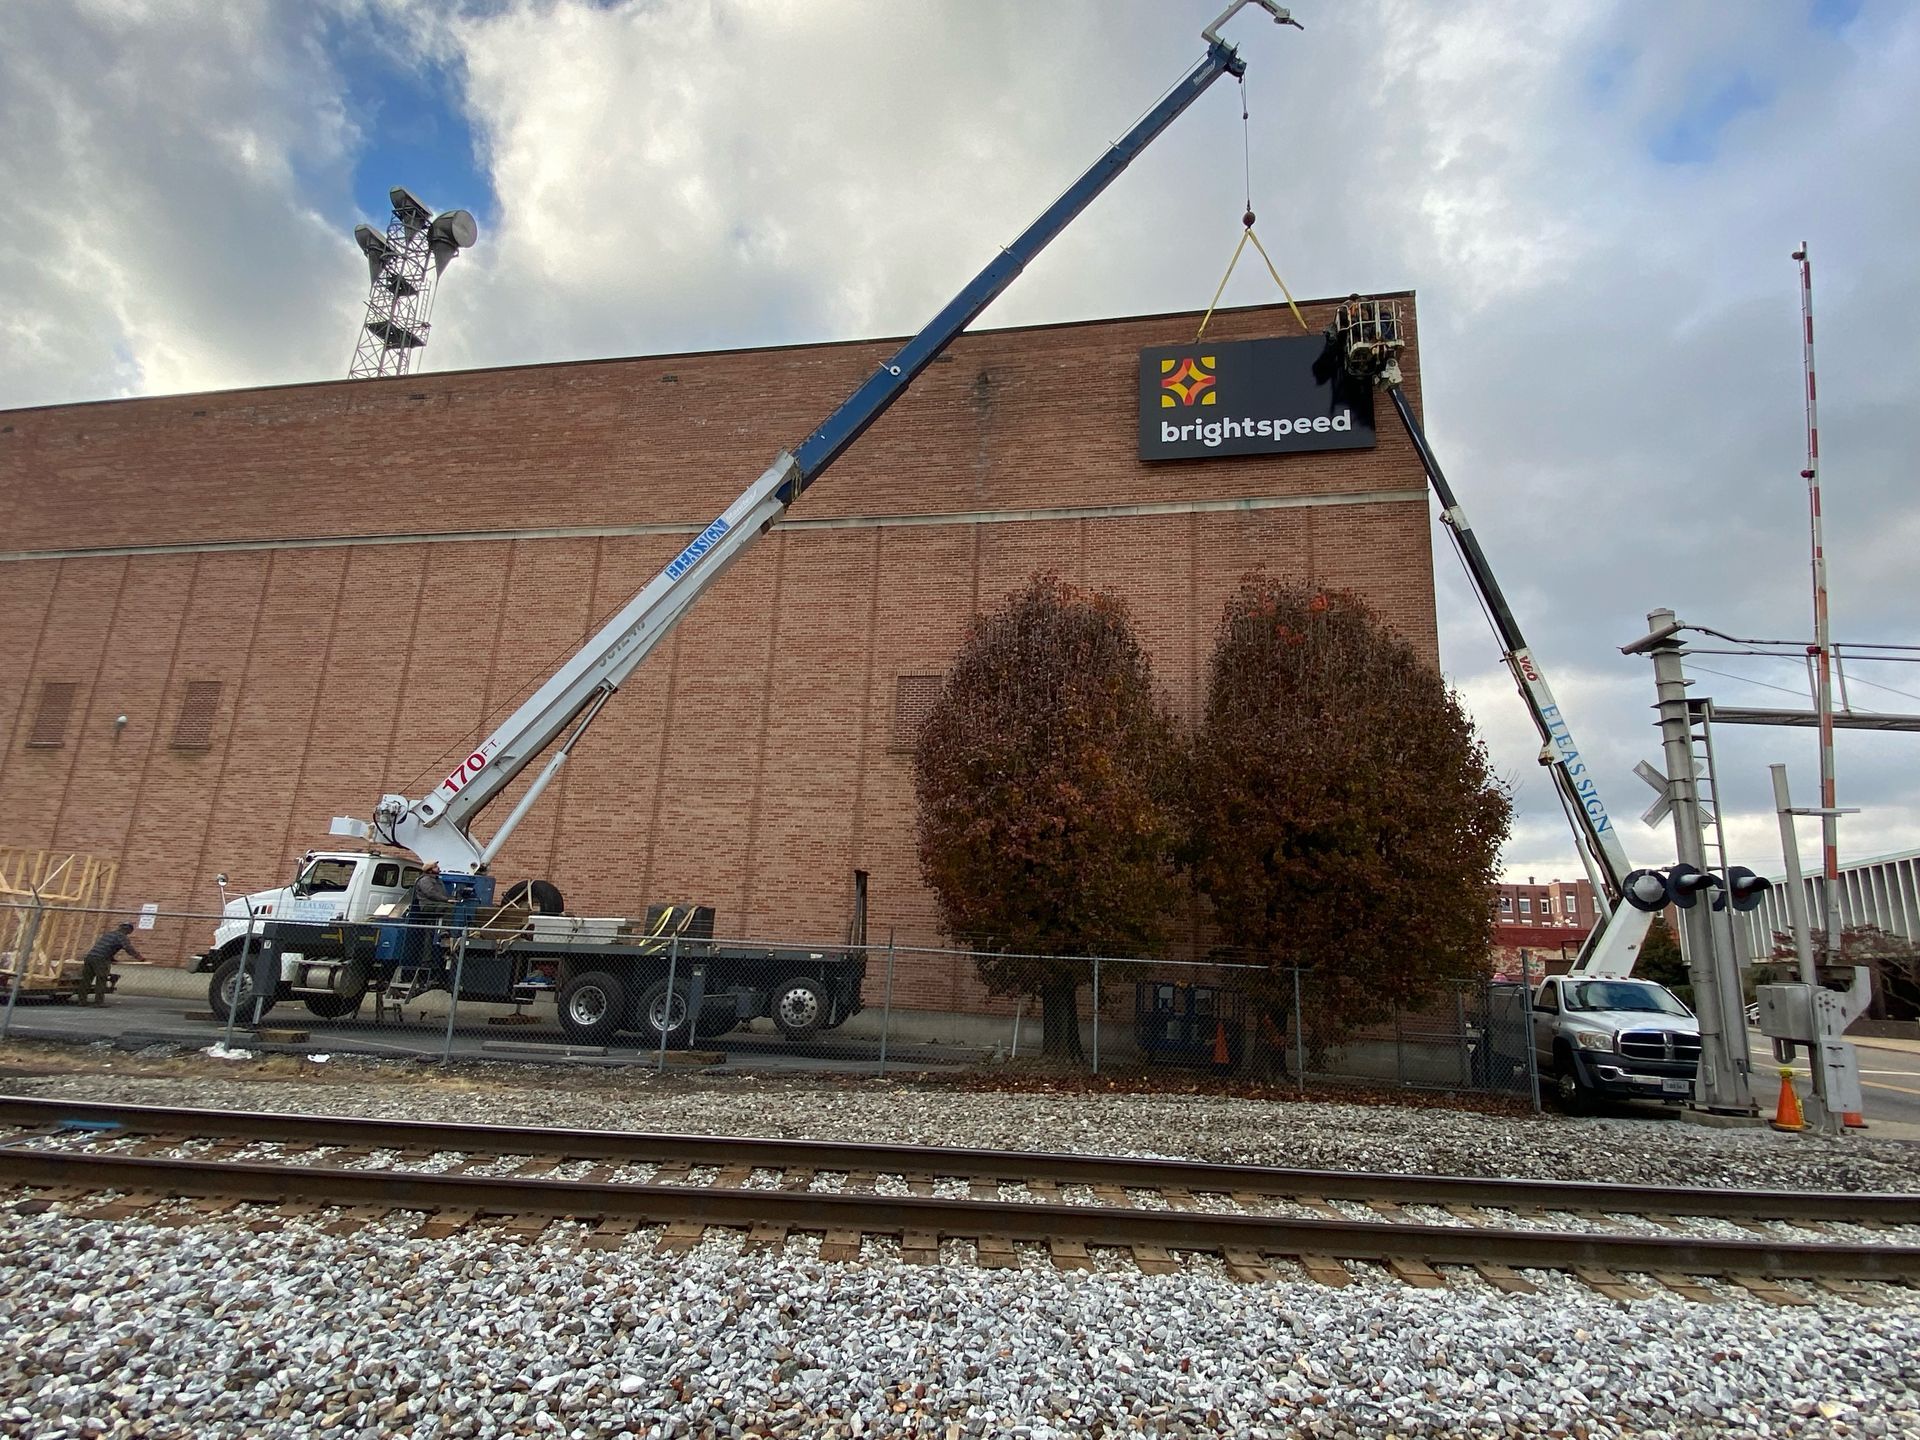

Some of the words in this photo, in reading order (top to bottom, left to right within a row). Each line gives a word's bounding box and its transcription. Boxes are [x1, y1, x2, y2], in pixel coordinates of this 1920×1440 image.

[1161, 409, 1352, 447] brightspeed
[666, 546, 703, 580] ELEAS
[697, 520, 727, 550] SIGN
[442, 753, 486, 792] 170
[1541, 704, 1586, 776] ELEAS
[1576, 779, 1613, 833] SIGN
